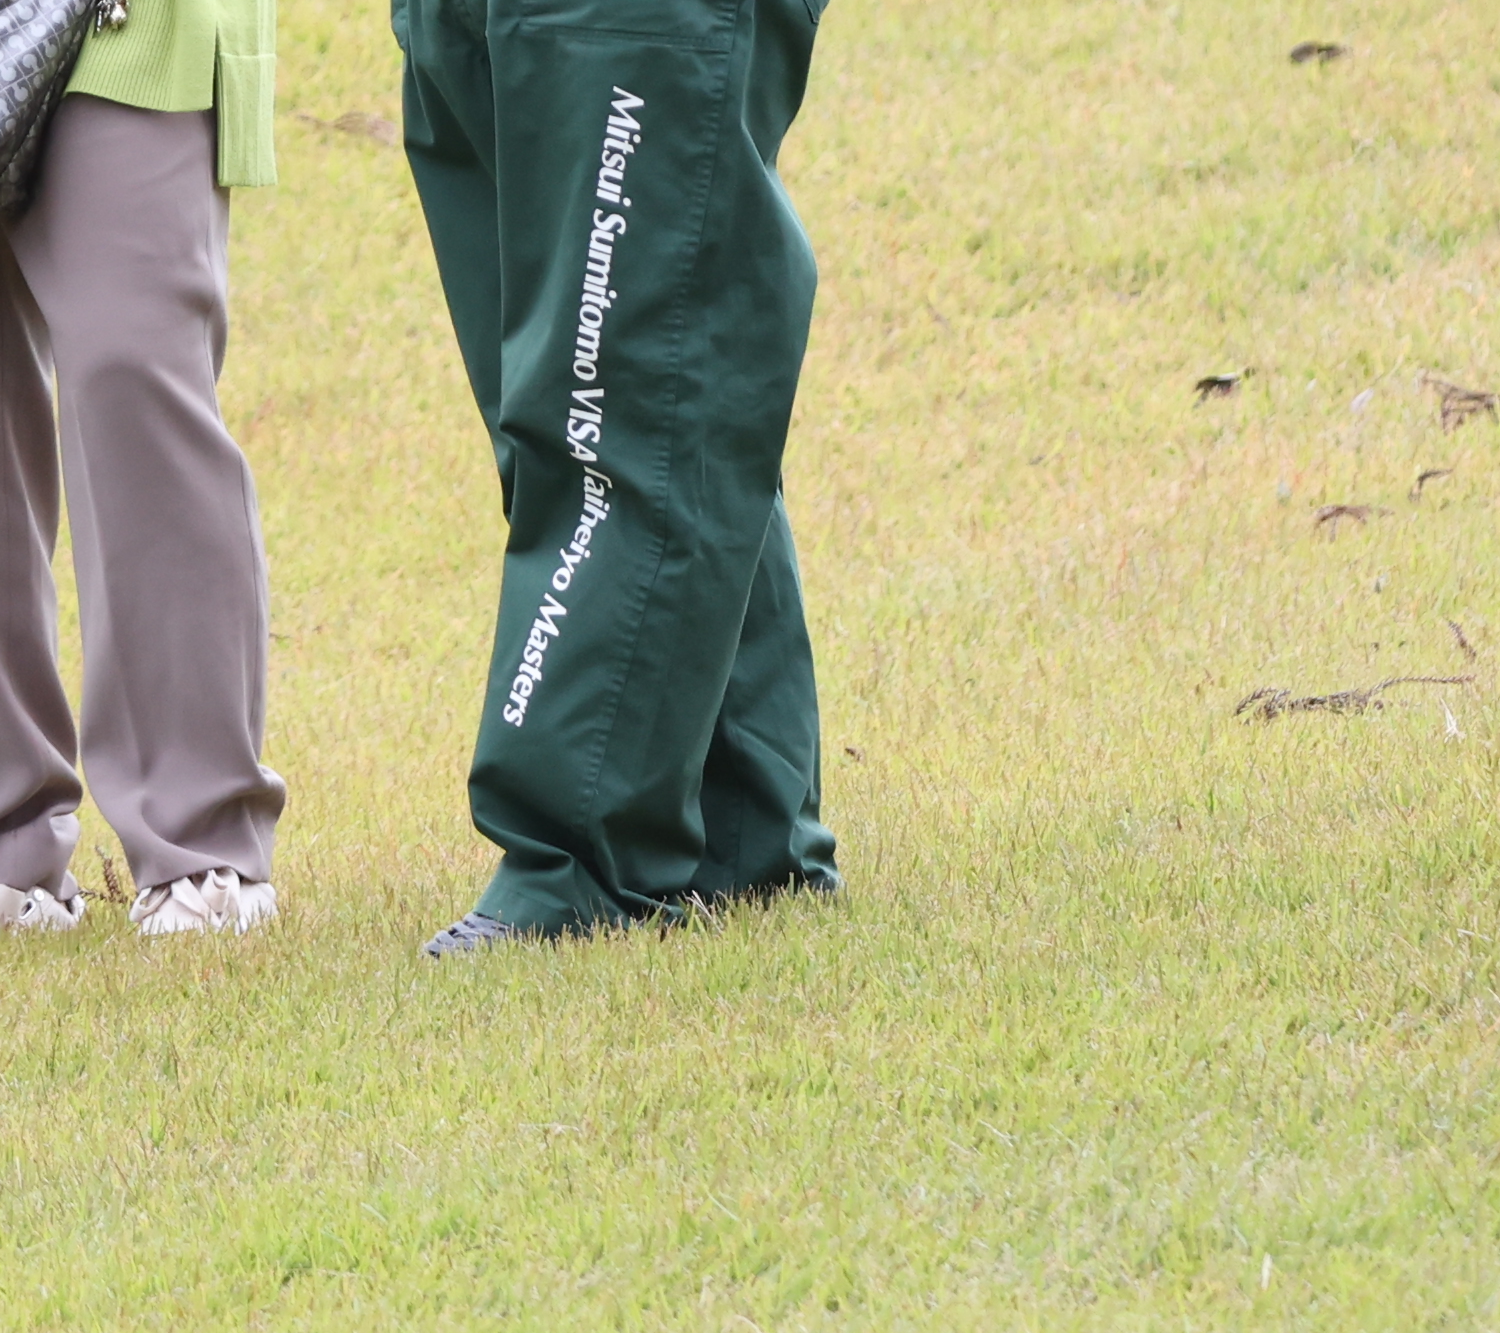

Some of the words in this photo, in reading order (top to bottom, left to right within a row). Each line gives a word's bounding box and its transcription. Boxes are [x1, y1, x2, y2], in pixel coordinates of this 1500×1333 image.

[594, 84, 645, 207] Mitsui
[570, 208, 628, 381] Sumitomo
[565, 386, 605, 464] VISA
[502, 590, 569, 729] Masters
